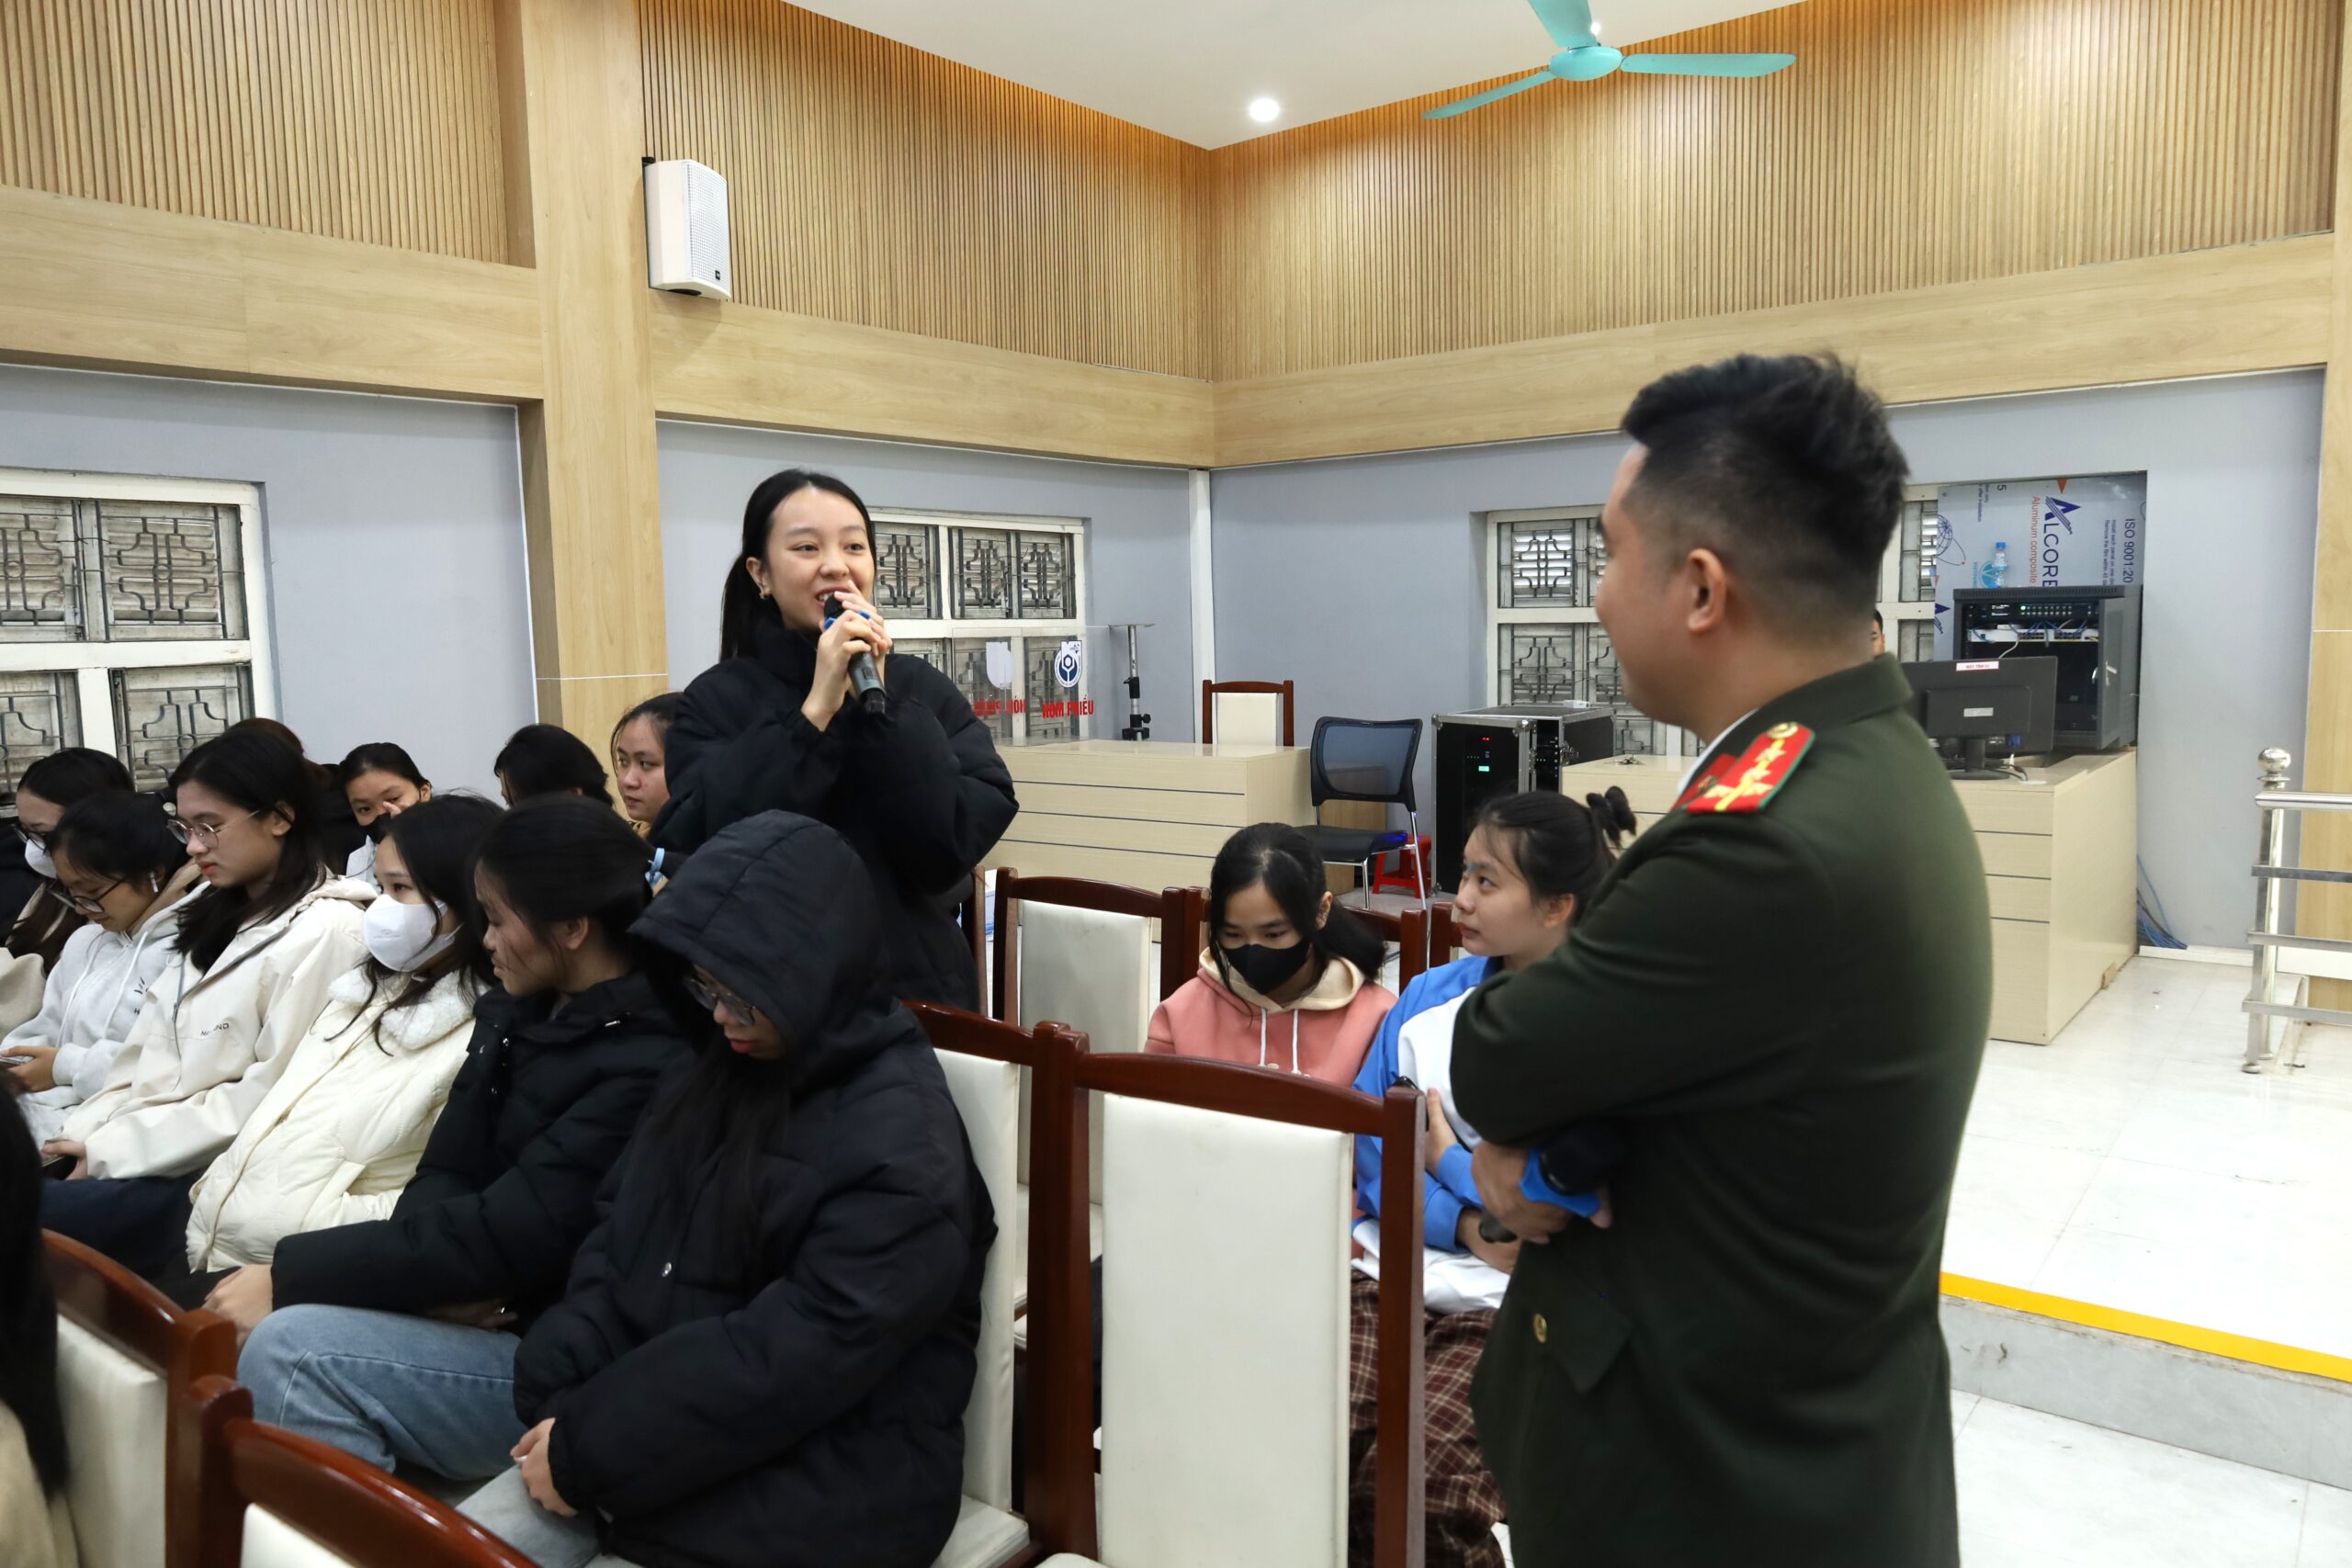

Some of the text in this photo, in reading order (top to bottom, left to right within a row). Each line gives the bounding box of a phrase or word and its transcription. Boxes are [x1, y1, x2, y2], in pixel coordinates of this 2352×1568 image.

[2028, 496, 2041, 583] Aluminum composite
[2124, 518, 2136, 538] ISO
